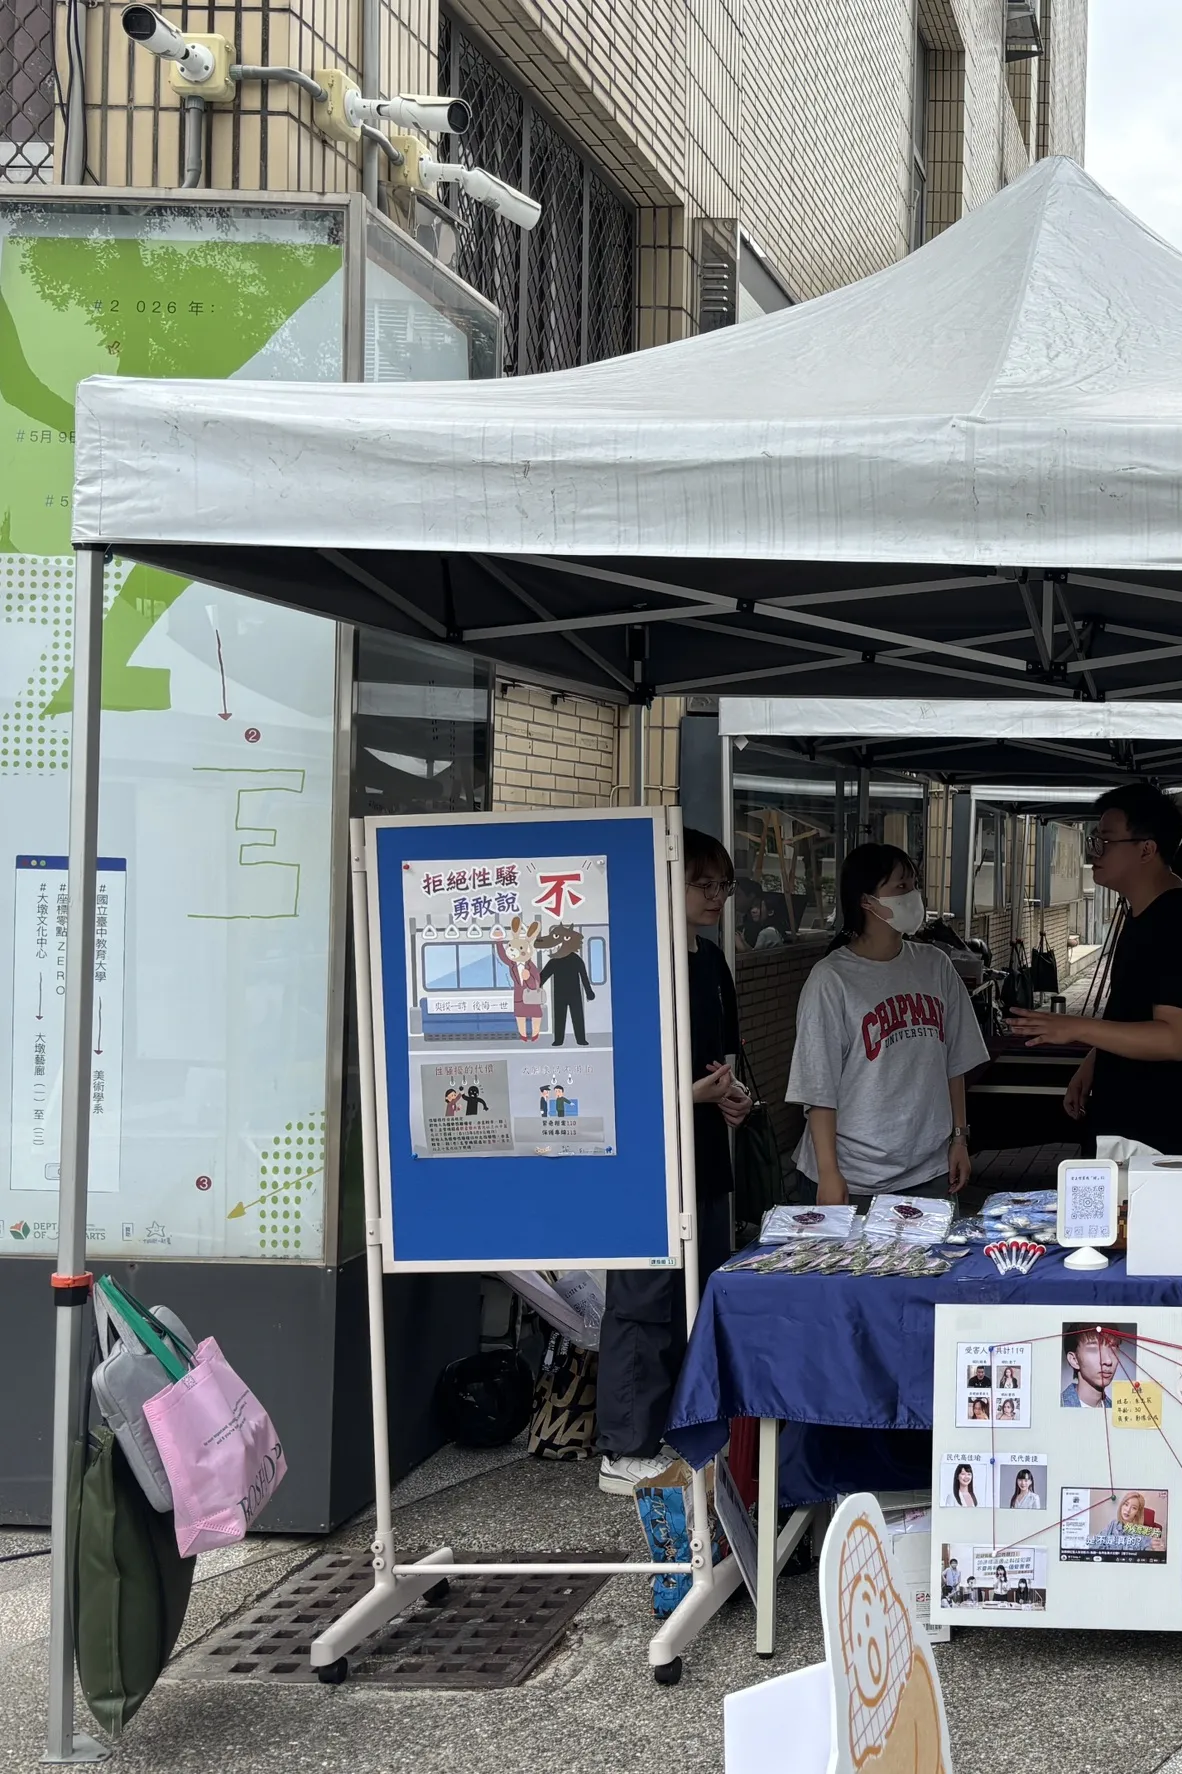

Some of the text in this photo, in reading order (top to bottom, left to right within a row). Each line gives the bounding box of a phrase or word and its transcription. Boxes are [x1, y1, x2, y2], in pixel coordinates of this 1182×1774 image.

[247, 728, 259, 742] 2
[422, 864, 518, 895] 拒絕性騷
[534, 873, 583, 917] 不
[35, 883, 49, 960] #大墩文化中心
[452, 891, 520, 921] 勇敢說
[55, 883, 69, 996] #座標零點 ZERO
[94, 884, 108, 983] #國立臺中教育大學
[92, 1070, 105, 1114] 美術學系
[198, 1176, 210, 1190] 3
[964, 1346, 988, 1355] 受害人
